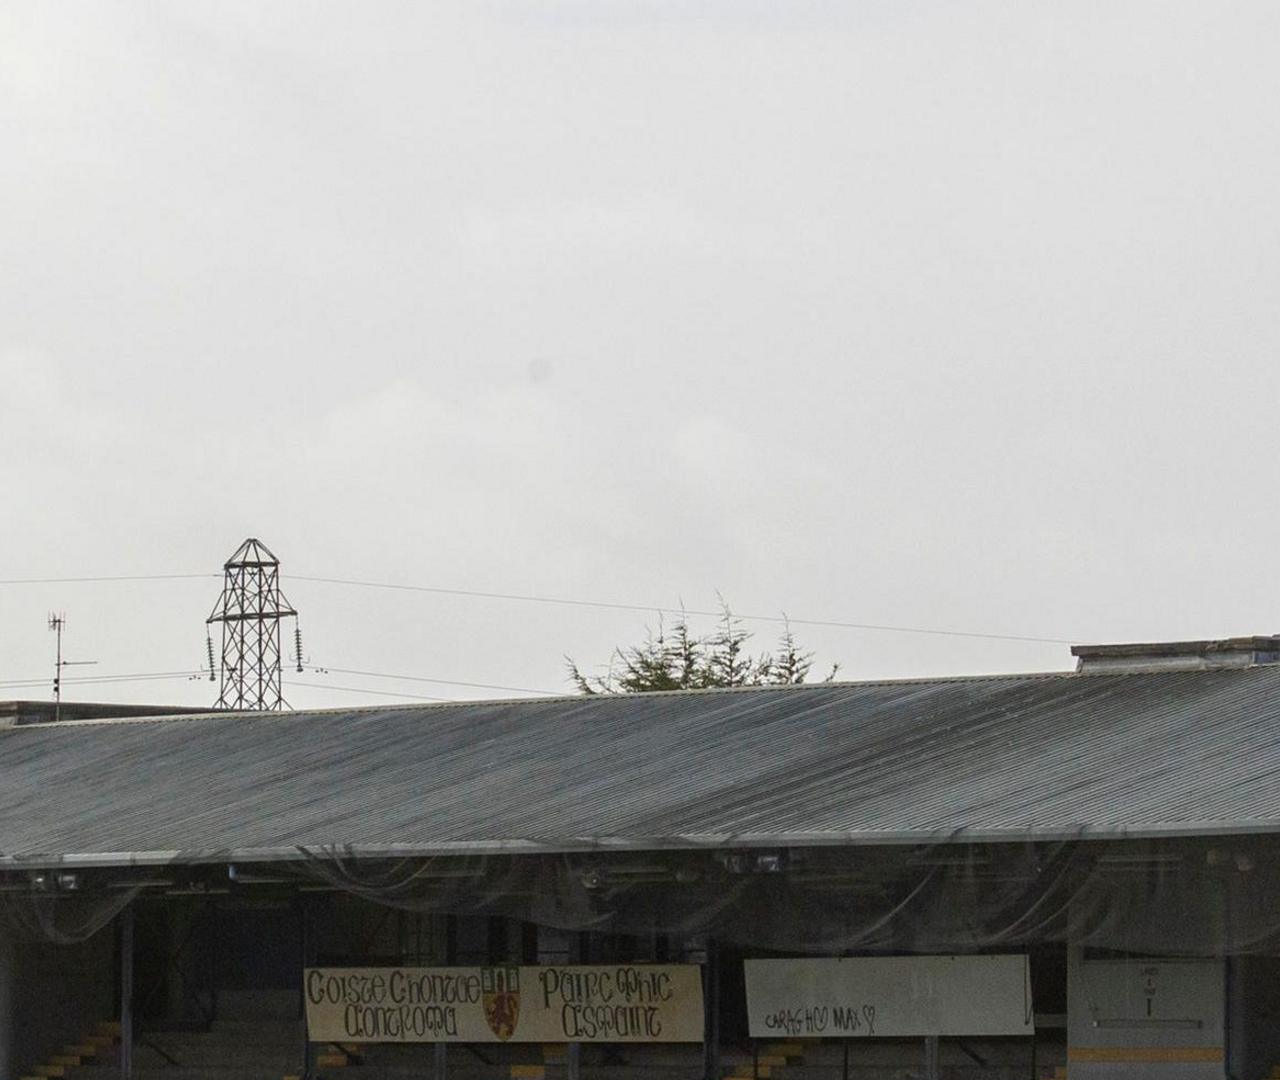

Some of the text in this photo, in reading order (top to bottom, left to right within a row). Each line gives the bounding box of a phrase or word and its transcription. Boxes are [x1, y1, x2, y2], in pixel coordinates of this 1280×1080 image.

[308, 970, 481, 1005] Coiste Chontae
[833, 1005, 861, 1031] MAX
